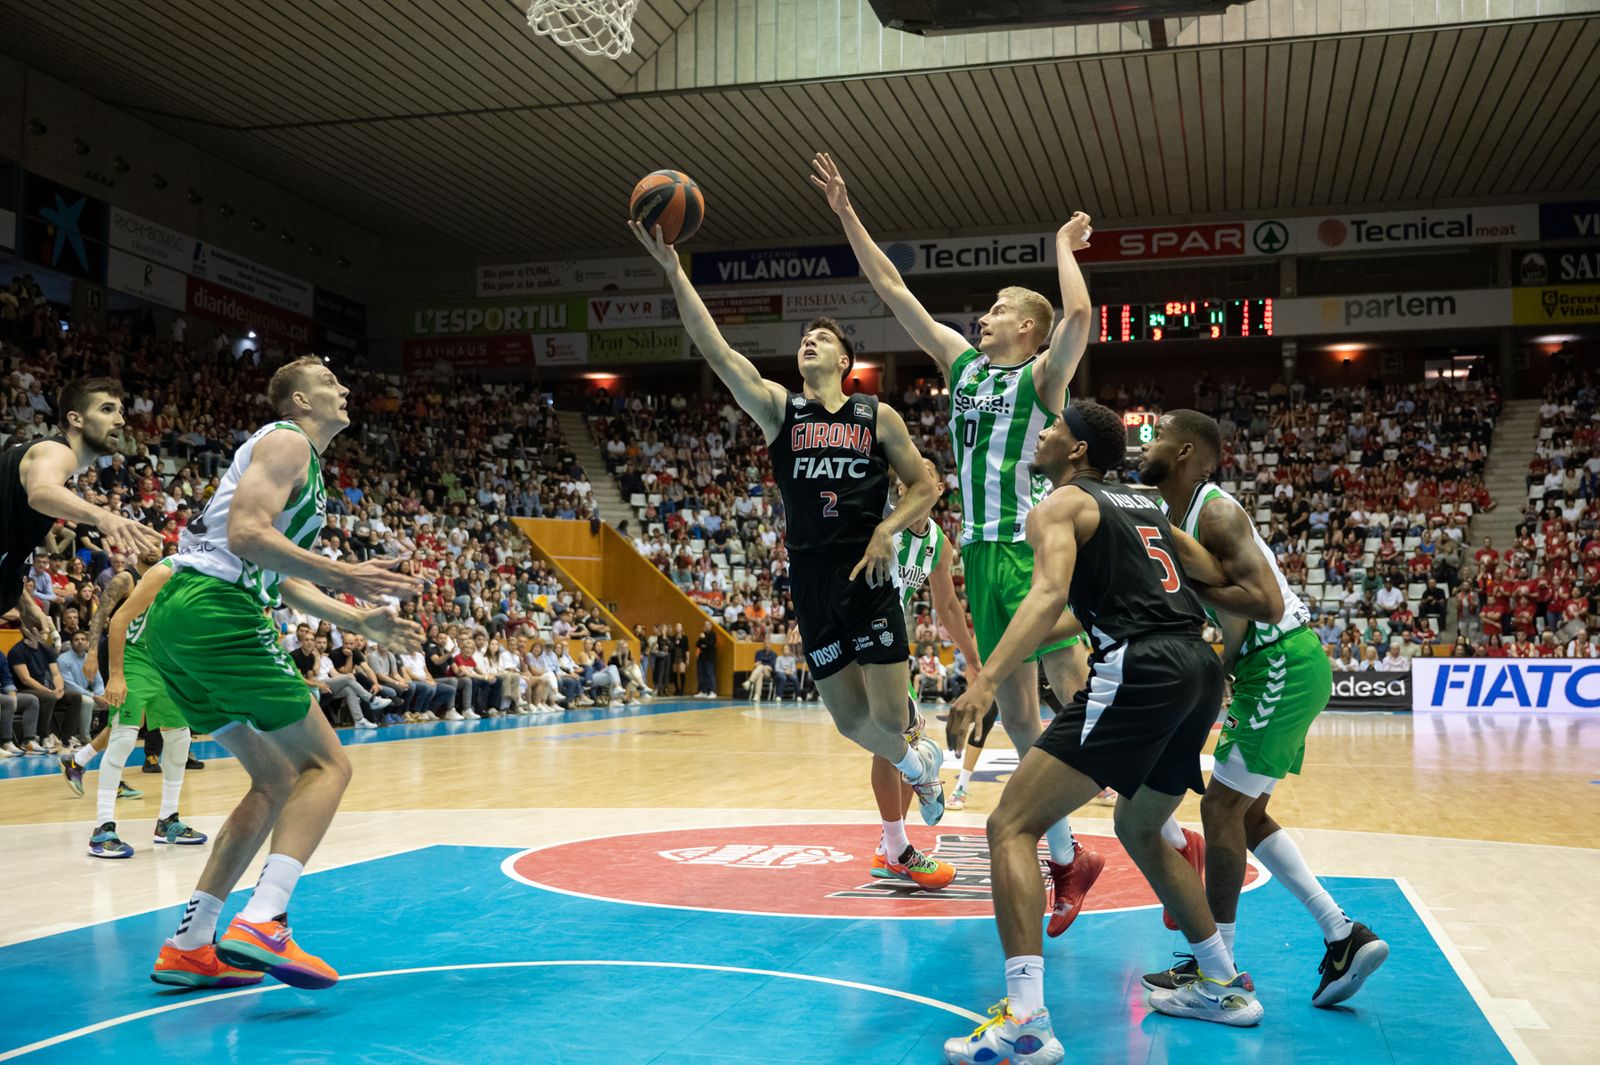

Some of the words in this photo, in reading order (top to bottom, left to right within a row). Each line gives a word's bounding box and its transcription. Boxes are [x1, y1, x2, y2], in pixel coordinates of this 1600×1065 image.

[1350, 214, 1473, 242] Tecnical
[1475, 224, 1515, 238] meat
[1120, 228, 1243, 256] SPAR
[750, 250, 799, 260] CATERING
[920, 237, 1045, 269] Tecnical
[483, 269, 496, 278] Bo
[498, 270, 515, 280] per
[717, 257, 832, 281] VILANOVA
[483, 280, 496, 290] Bo
[498, 281, 516, 291] per
[786, 294, 847, 307] FRISELVA
[1345, 295, 1456, 325] parlem
[193, 286, 309, 344] diaridegirona.cat
[415, 304, 568, 335] L'ESPORTIU
[1149, 313, 1165, 326] 24
[1211, 311, 1223, 323] 11
[590, 332, 623, 351] Prat
[1152, 328, 1162, 341] 3
[1211, 325, 1220, 338] 3
[415, 343, 489, 359] BAUHAUS
[546, 337, 556, 358] 5
[791, 422, 872, 457] GIRONA
[964, 418, 977, 448] 0
[1139, 423, 1153, 443] 8
[793, 457, 870, 479] FIATC
[820, 491, 839, 517] 2
[1101, 489, 1160, 510] TAYLOR
[1135, 525, 1181, 593] 5
[809, 640, 843, 667] YOSOY
[860, 641, 874, 649] Home
[1431, 664, 1600, 708] FIATC
